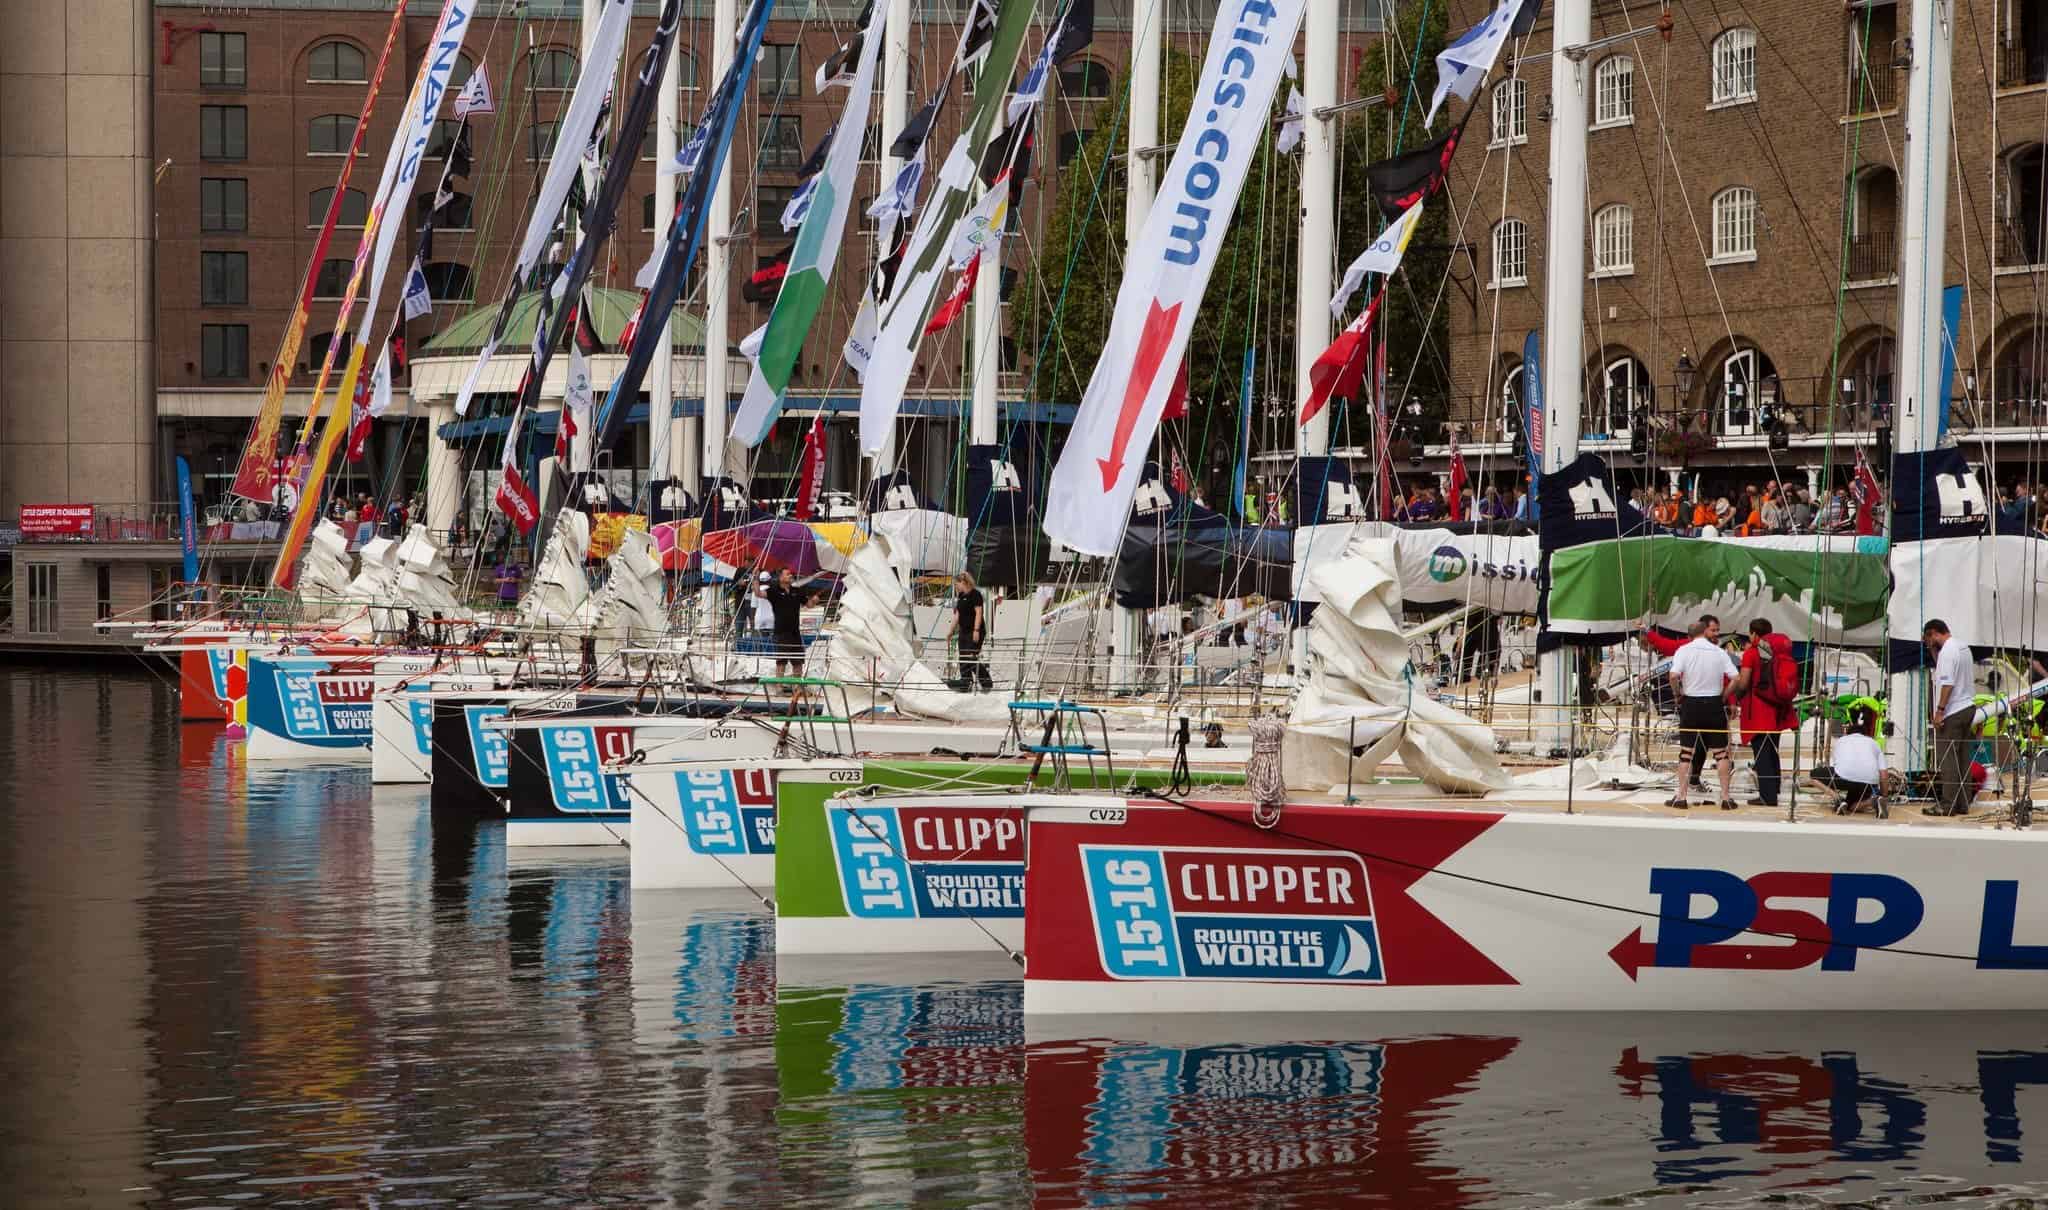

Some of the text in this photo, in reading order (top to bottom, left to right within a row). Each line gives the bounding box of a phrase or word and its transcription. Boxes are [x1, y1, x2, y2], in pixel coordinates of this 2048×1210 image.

[549, 701, 573, 709] CV20
[710, 728, 737, 739] CV31
[554, 729, 599, 803] 15-16
[829, 771, 861, 782] CV23
[1089, 808, 1126, 821] CV22
[913, 817, 1024, 851] CLIPP
[847, 815, 904, 909] 15-16
[927, 875, 993, 888] ROUND
[1181, 863, 1354, 904] CLIPPER
[1104, 859, 1168, 967] 15-16
[1649, 867, 1925, 971] PSP
[1195, 928, 1323, 946] ROUND THE
[1195, 943, 1325, 968] WORLD
